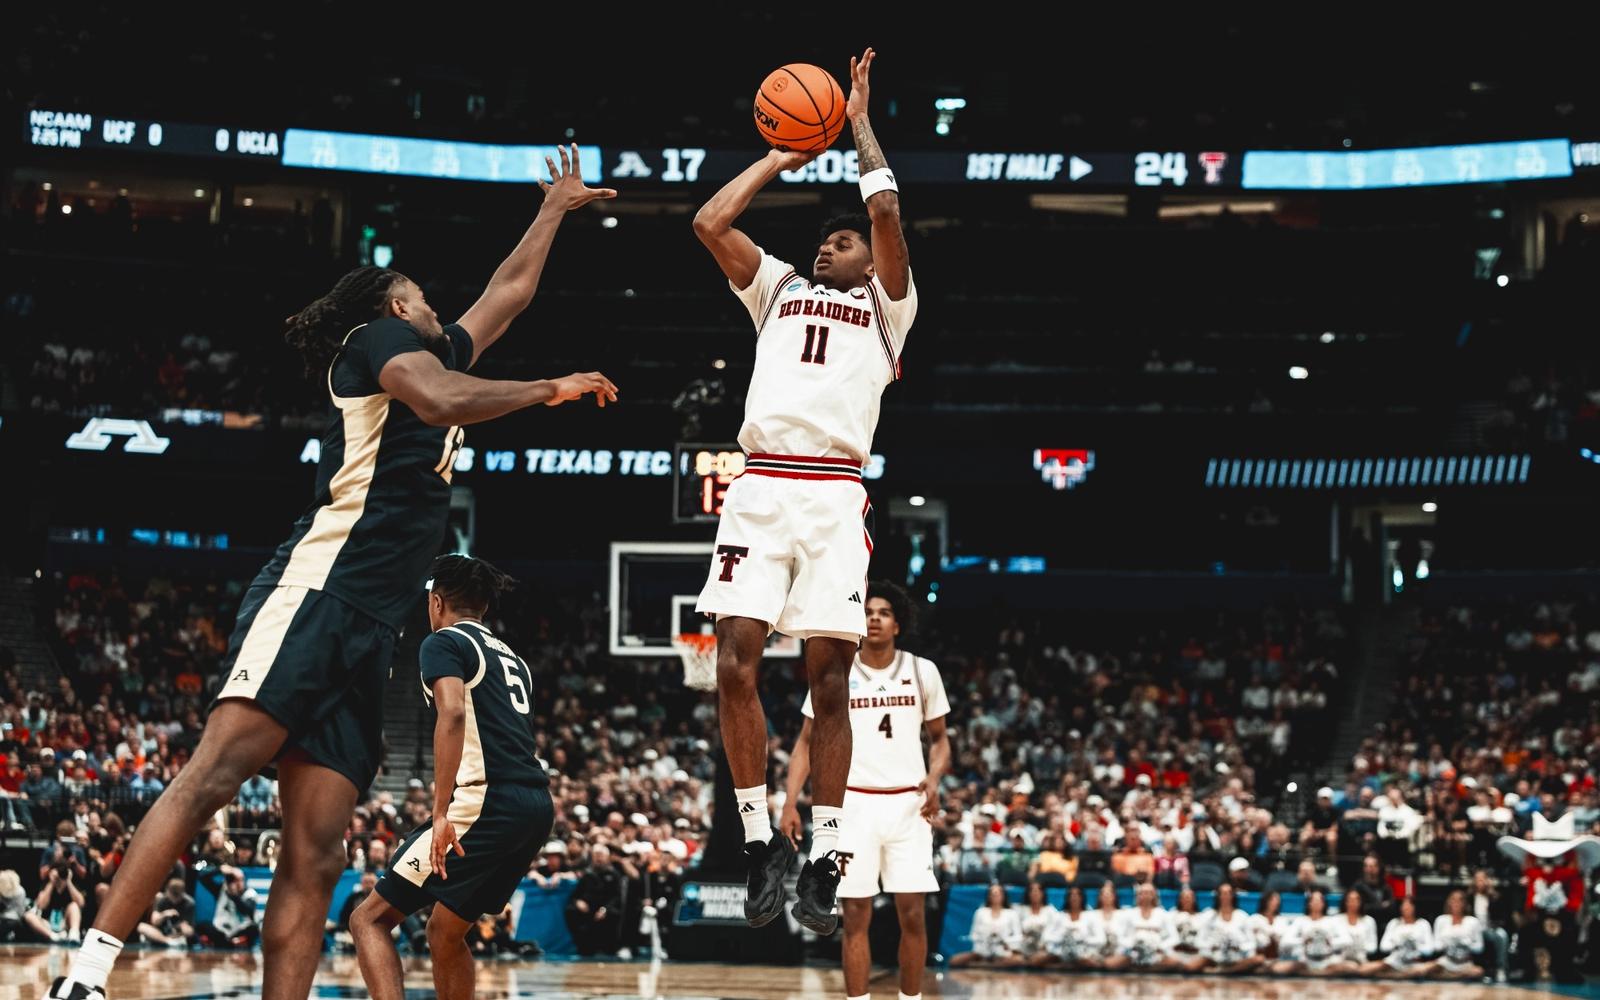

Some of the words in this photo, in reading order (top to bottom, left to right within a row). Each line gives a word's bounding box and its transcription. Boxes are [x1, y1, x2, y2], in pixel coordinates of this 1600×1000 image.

[59, 129, 82, 148] PM
[102, 119, 136, 144] UCF
[148, 123, 163, 147] 0
[215, 128, 230, 152] 0
[236, 131, 279, 155] UCLA
[661, 148, 706, 182] 17
[966, 153, 1007, 180] 1ST
[1006, 153, 1063, 180] HALF
[1134, 152, 1188, 186] 24
[778, 300, 802, 319] RED
[803, 299, 872, 328] RAIDERS
[800, 324, 830, 365] 11
[485, 451, 516, 471] VS
[525, 449, 613, 475] TEXAS
[498, 655, 530, 714] 5
[850, 698, 870, 709] RED
[871, 695, 916, 708] RAIDERS
[878, 713, 893, 739] 4
